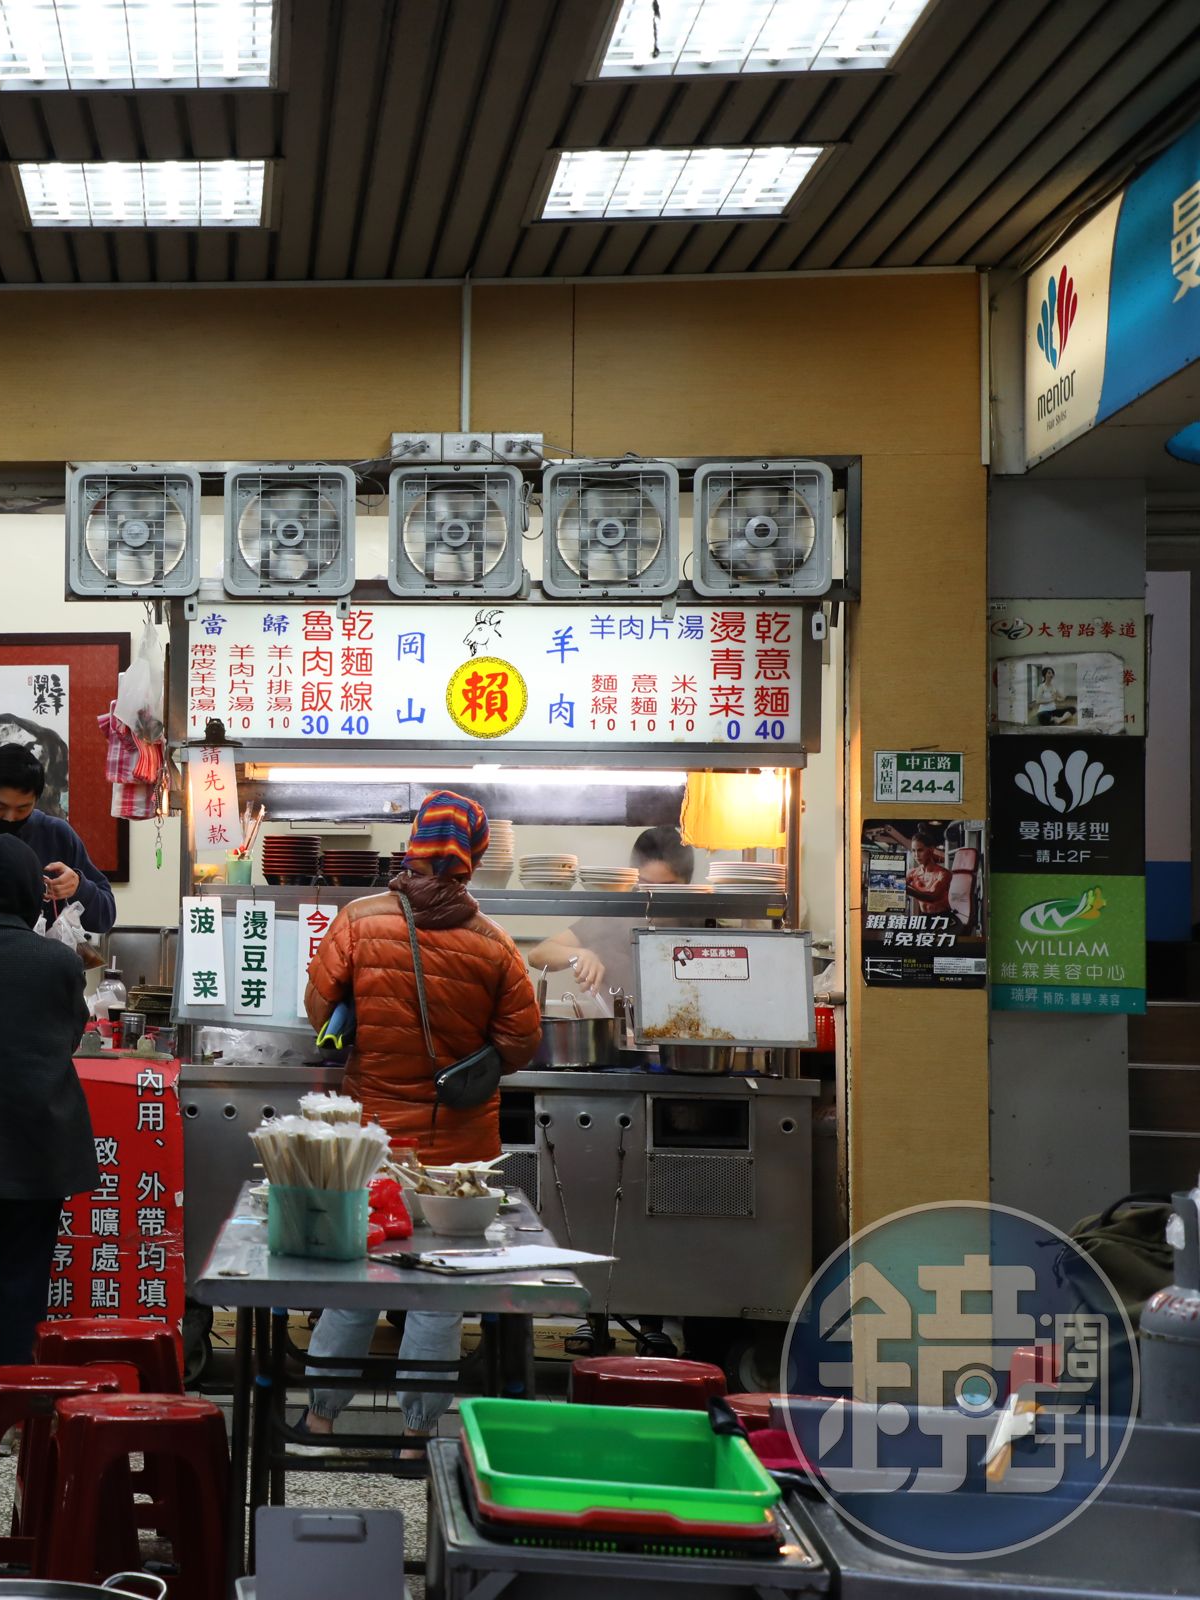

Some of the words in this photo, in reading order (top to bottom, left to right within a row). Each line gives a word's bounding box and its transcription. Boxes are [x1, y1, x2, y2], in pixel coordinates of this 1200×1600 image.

[1037, 369, 1076, 421] mentor
[589, 614, 704, 640] 羊肉片湯
[190, 644, 217, 712] 帶皮羊肉湯
[228, 644, 255, 713] 羊肉片湯
[266, 644, 293, 713] 羊小排湯
[300, 610, 334, 713] 魯肉飯
[340, 610, 374, 713] 乾麵線
[396, 631, 426, 725] 岡山
[545, 625, 579, 729] 羊肉
[709, 611, 746, 718] 燙青菜
[754, 611, 791, 718] 乾意麵
[461, 671, 508, 723] 賴
[591, 674, 618, 716] 麵線
[631, 674, 658, 716] 意麵
[671, 674, 698, 716] 米粉
[301, 715, 329, 735] 30
[341, 715, 369, 735] 40
[755, 720, 785, 740] 40
[879, 755, 894, 796] 新店區
[905, 756, 952, 771] 中正路
[200, 747, 230, 845] 請先付款
[900, 778, 956, 794] 244-4
[1019, 821, 1110, 841] 曼都髮型
[1036, 850, 1091, 863] 請上2F
[241, 910, 268, 1009] 燙豆芽
[894, 932, 956, 948] 免疫力
[1015, 939, 1110, 957] WILLIAM
[1000, 962, 1126, 981] 維霖美容中心
[90, 1137, 120, 1325] 致空曠處點
